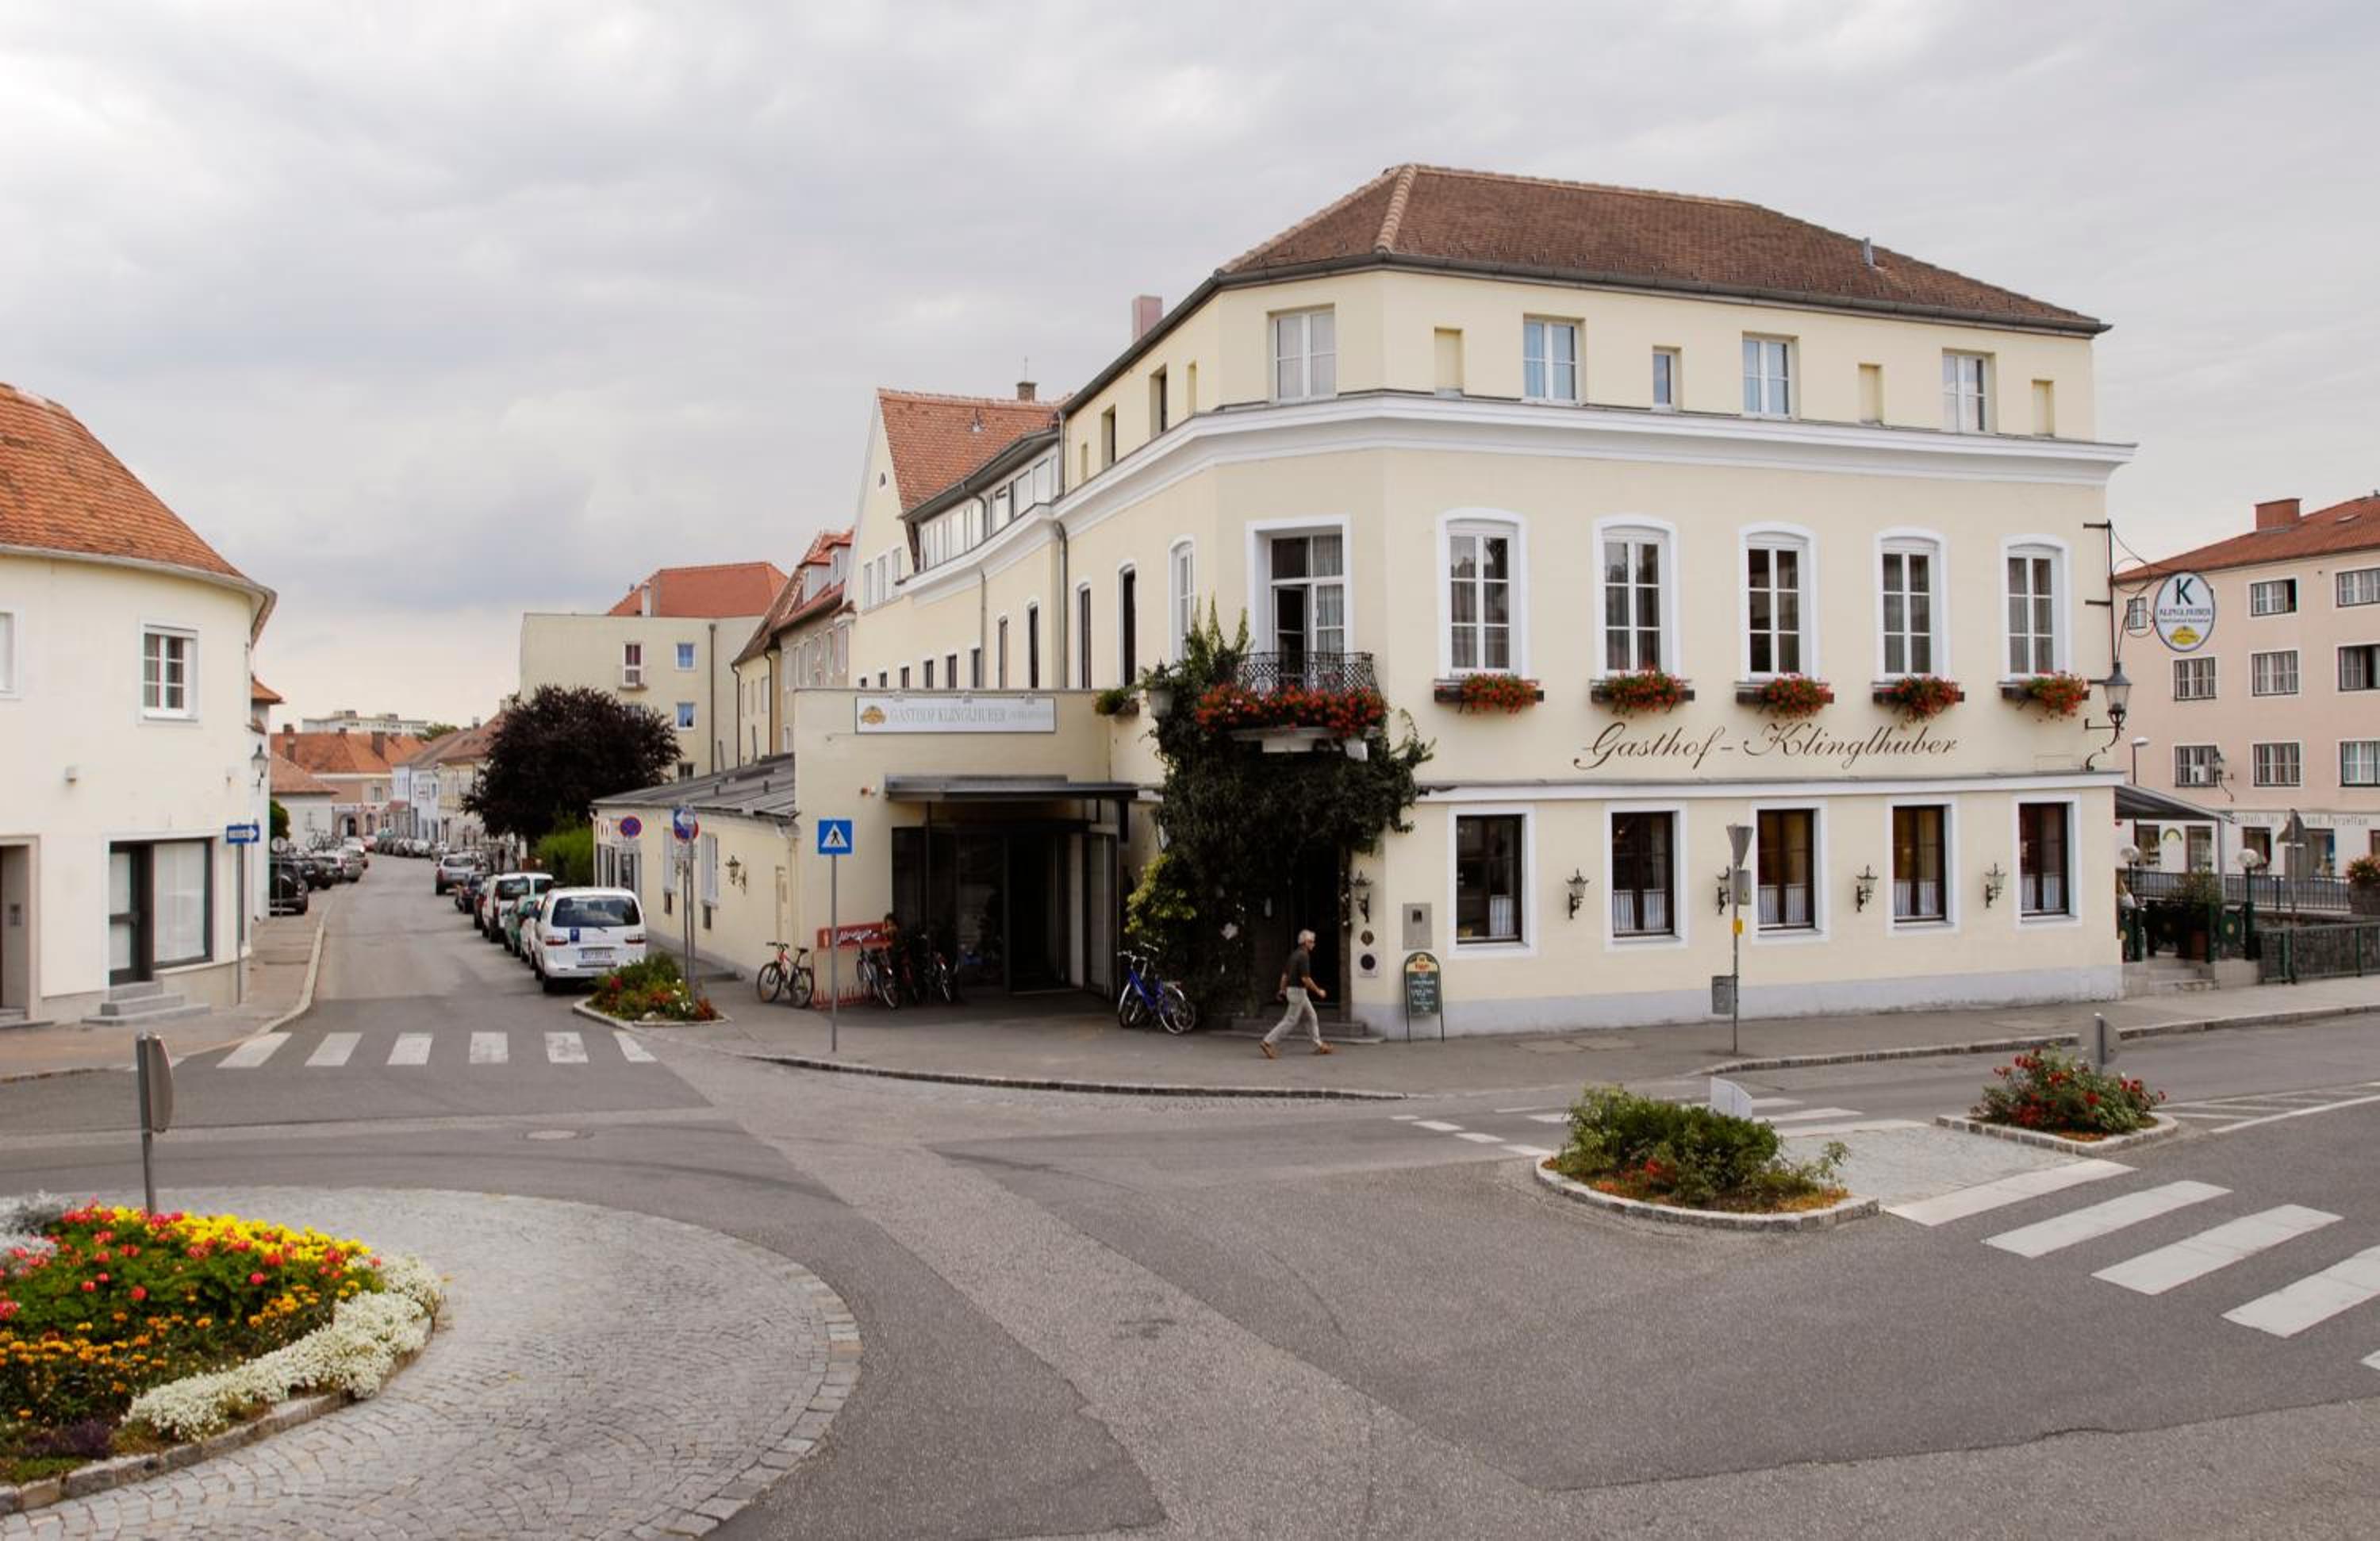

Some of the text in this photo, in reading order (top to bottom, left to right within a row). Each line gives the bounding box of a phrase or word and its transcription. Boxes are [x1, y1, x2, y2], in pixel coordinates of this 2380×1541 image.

[2175, 578, 2194, 605] K
[1573, 721, 1726, 770] Gasthof
[1743, 723, 1957, 770] Klinglhuber
